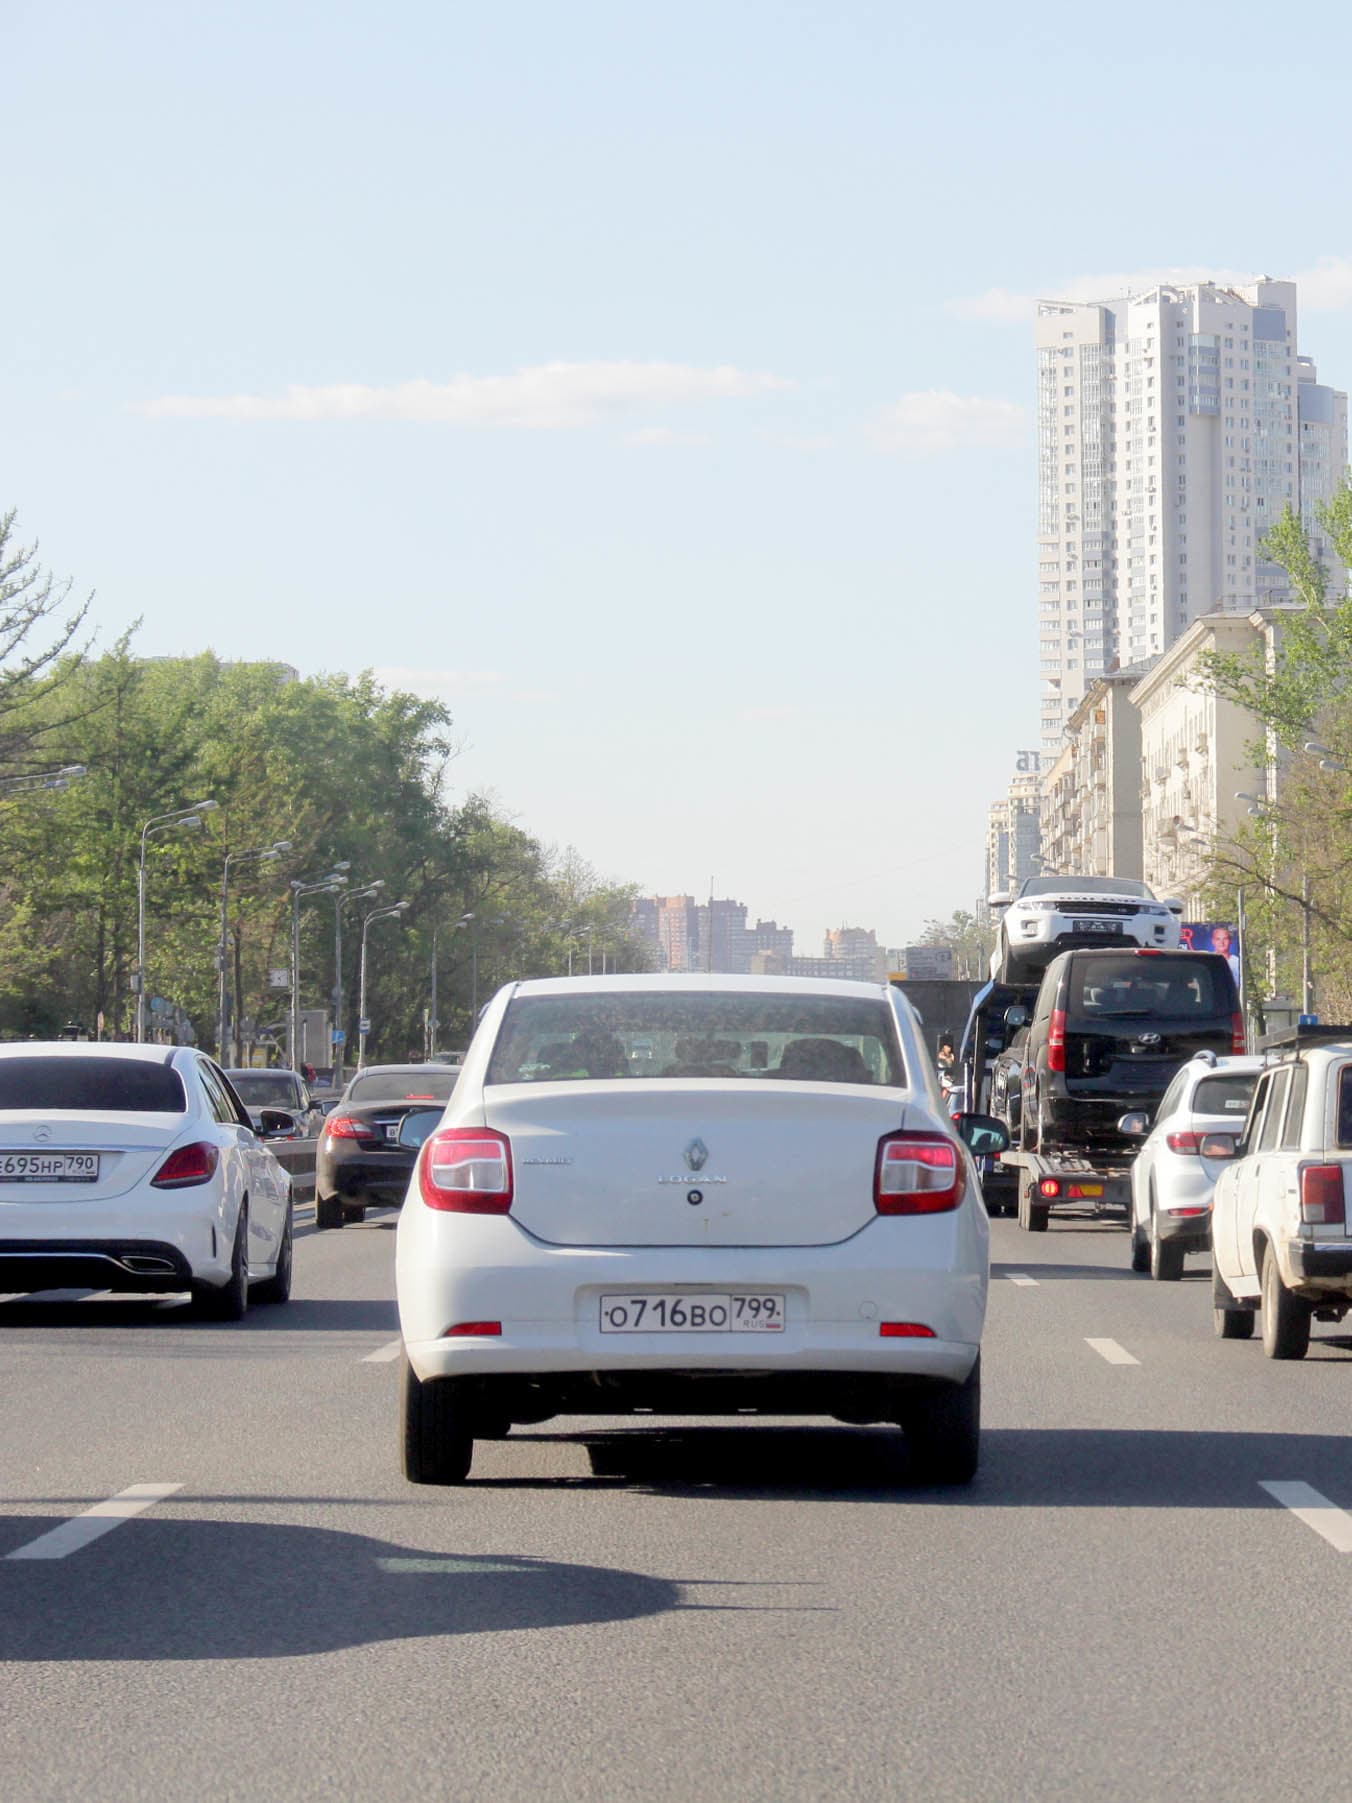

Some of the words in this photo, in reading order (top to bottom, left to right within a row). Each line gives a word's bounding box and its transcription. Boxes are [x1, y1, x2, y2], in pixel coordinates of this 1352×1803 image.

[0, 1157, 63, 1173] 695НР
[65, 1157, 94, 1169] 790
[658, 1175, 728, 1184] LOGAN
[733, 1297, 777, 1319] 799
